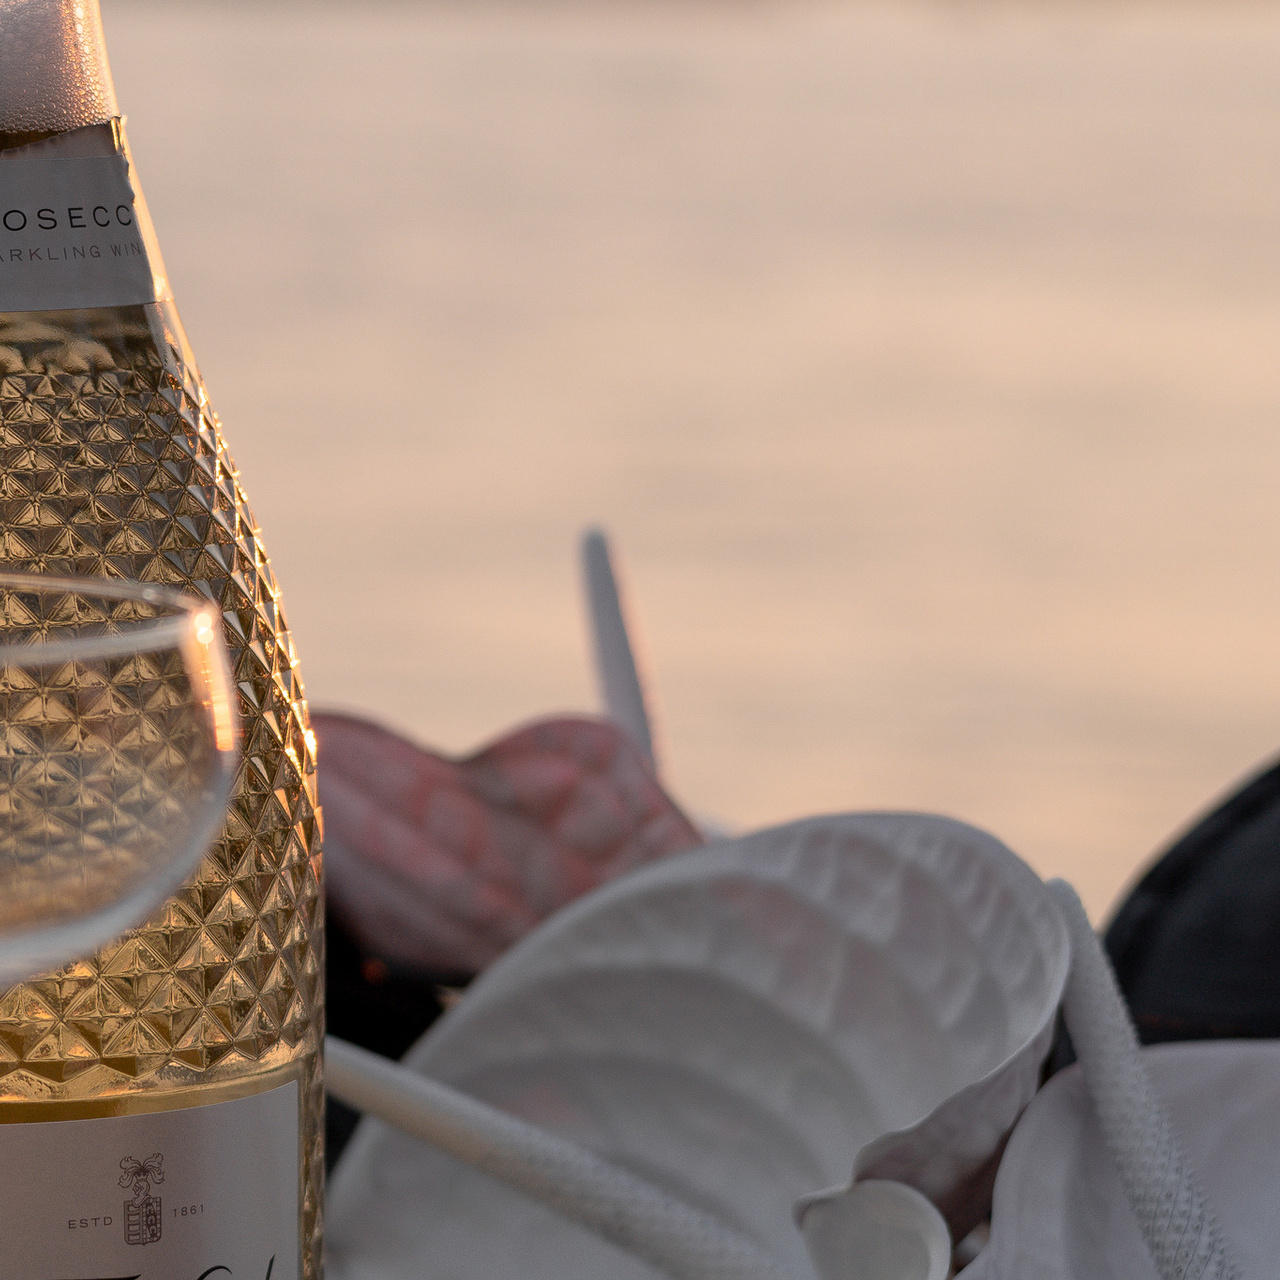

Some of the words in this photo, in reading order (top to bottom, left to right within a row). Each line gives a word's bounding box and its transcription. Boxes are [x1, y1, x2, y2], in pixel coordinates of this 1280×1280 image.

[109, 241, 142, 258] WIN
[67, 1216, 113, 1230] ESTD
[172, 1203, 206, 1218] 1861
